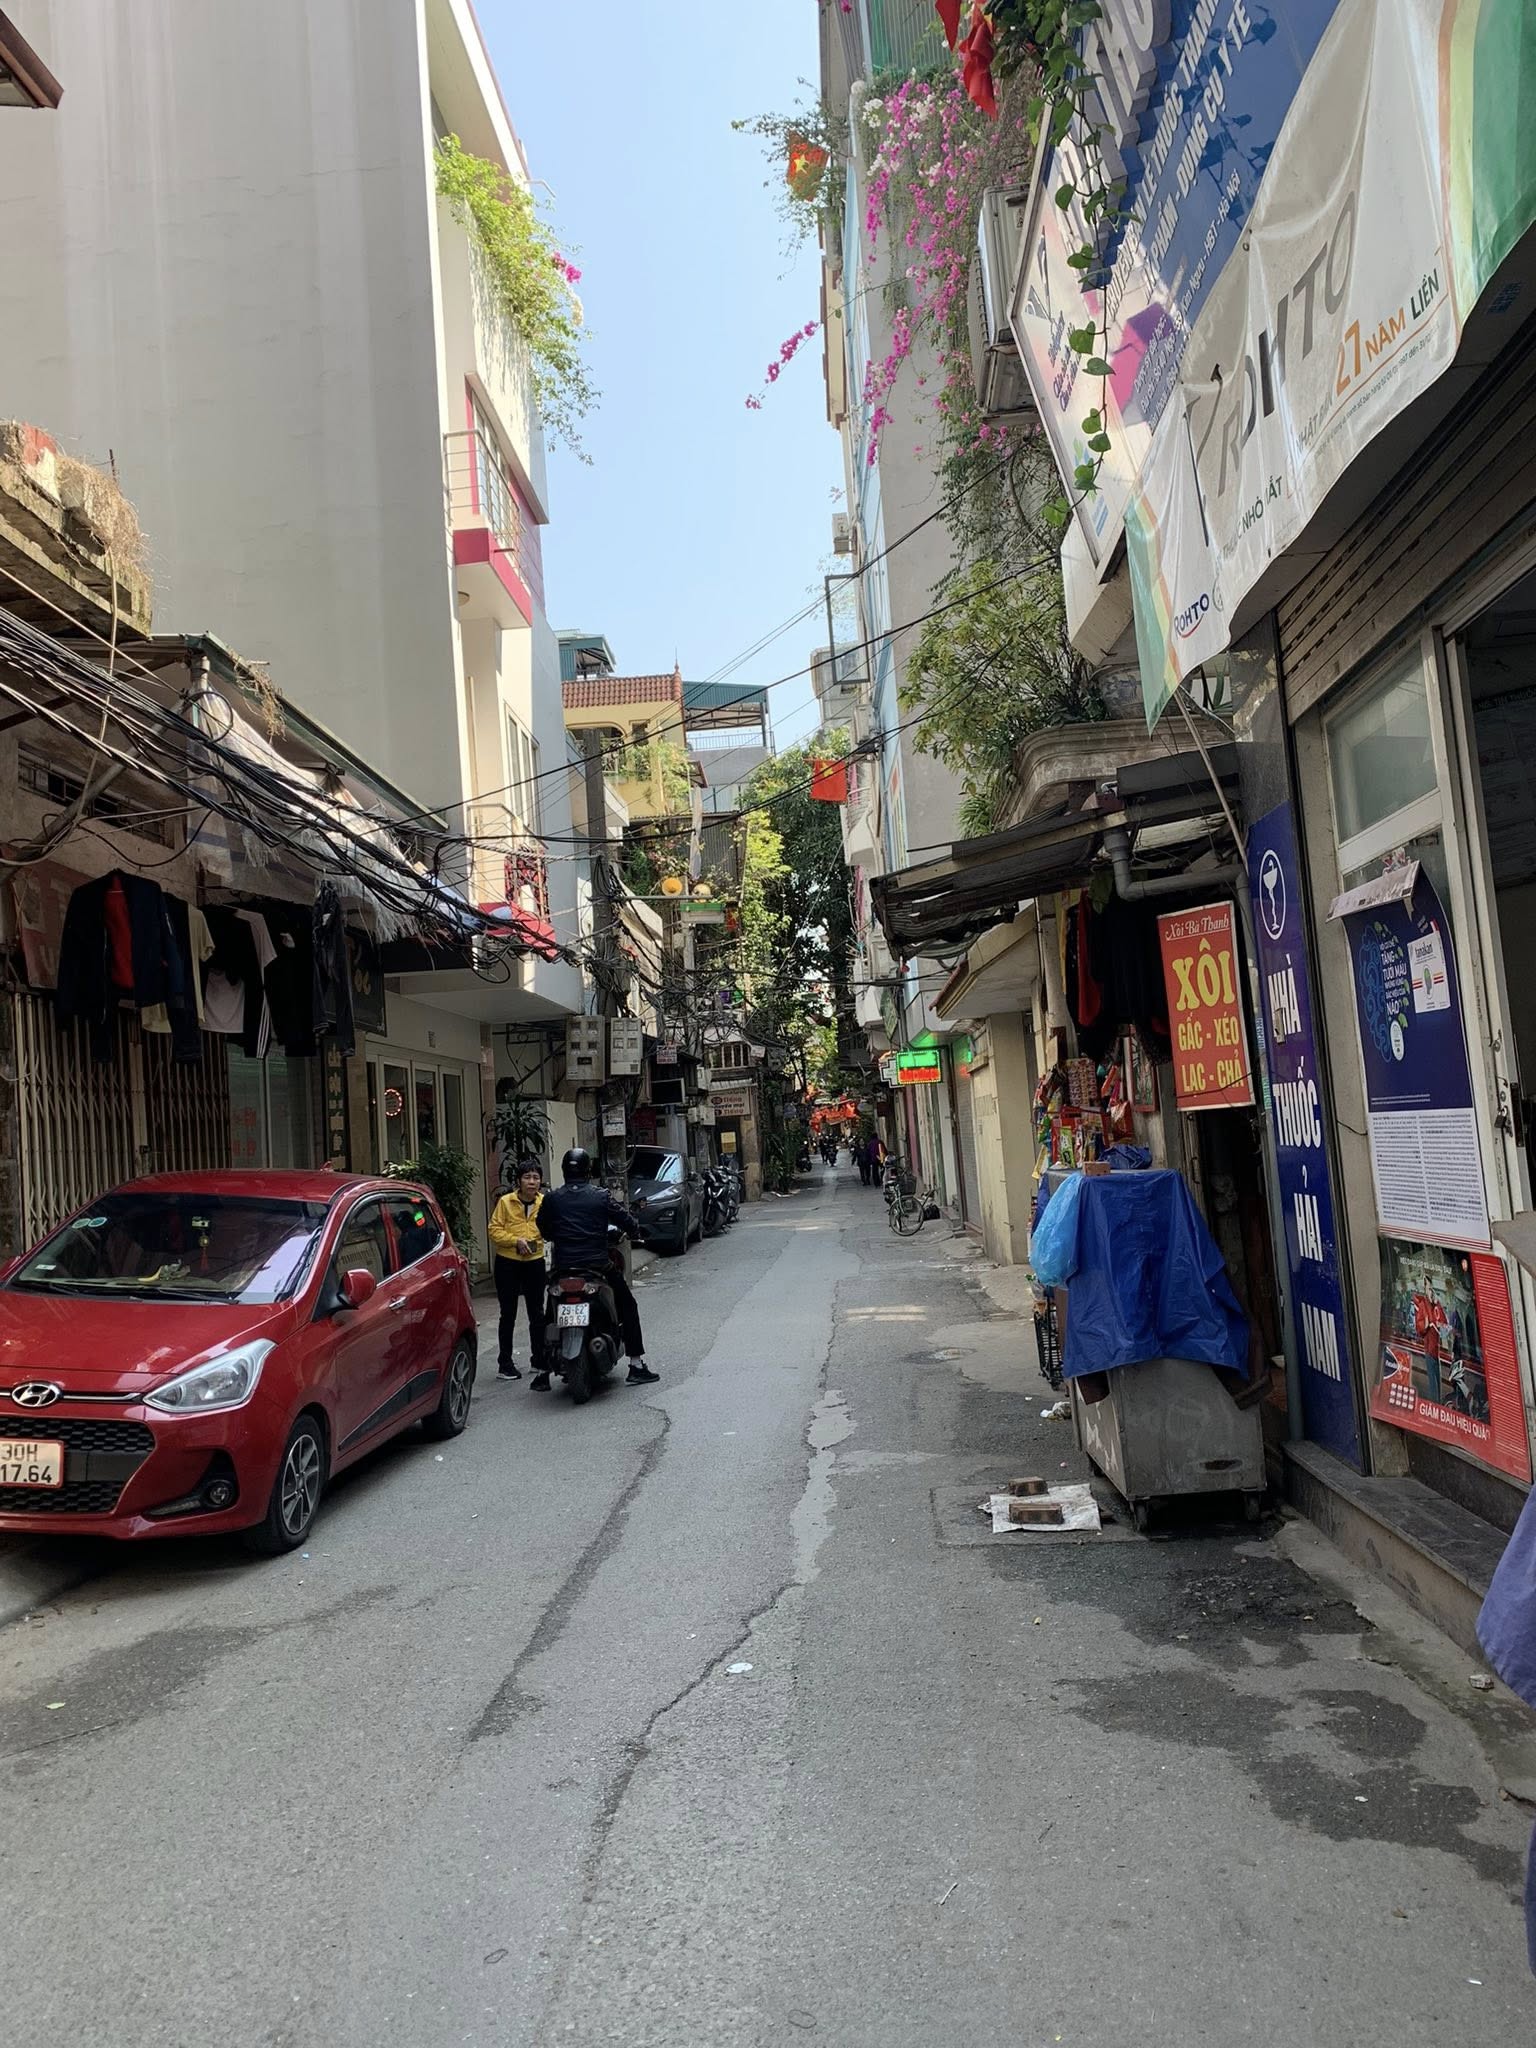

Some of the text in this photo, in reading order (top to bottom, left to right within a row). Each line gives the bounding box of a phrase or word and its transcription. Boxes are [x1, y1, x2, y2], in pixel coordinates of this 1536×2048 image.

[1150, 81, 1184, 175] THUỐC
[1151, 194, 1180, 268] PHẨM
[1176, 111, 1209, 198] DỤNG
[1203, 66, 1226, 123] CỤ
[1218, 37, 1233, 77] Y
[1204, 219, 1218, 256] HBT
[1218, 196, 1230, 222] Hà
[1226, 168, 1241, 201] Nội
[1336, 319, 1361, 397] 27
[1365, 308, 1406, 362] NĂM
[1410, 268, 1439, 320] LIỀN
[1242, 496, 1264, 533] NHỎ
[1174, 593, 1210, 638] ROHTO
[1185, 919, 1200, 934] Bà
[1200, 914, 1230, 932] Thanh
[1172, 937, 1235, 1012] XÔI
[1268, 953, 1302, 1038] NHÀ
[1178, 1012, 1203, 1051] GẤC
[1214, 1011, 1239, 1047] XÉO
[1217, 1049, 1245, 1089] CHẢ
[1272, 1055, 1321, 1148] THUỐC
[1294, 1164, 1324, 1262] HẢI
[1301, 1301, 1342, 1382] NAM
[1, 1443, 38, 1462] 30H
[1420, 1402, 1439, 1420] GIẢM
[1440, 1408, 1456, 1426] ĐAU
[1456, 1415, 1472, 1435] HIỆU
[1, 1464, 52, 1483] 17.64
